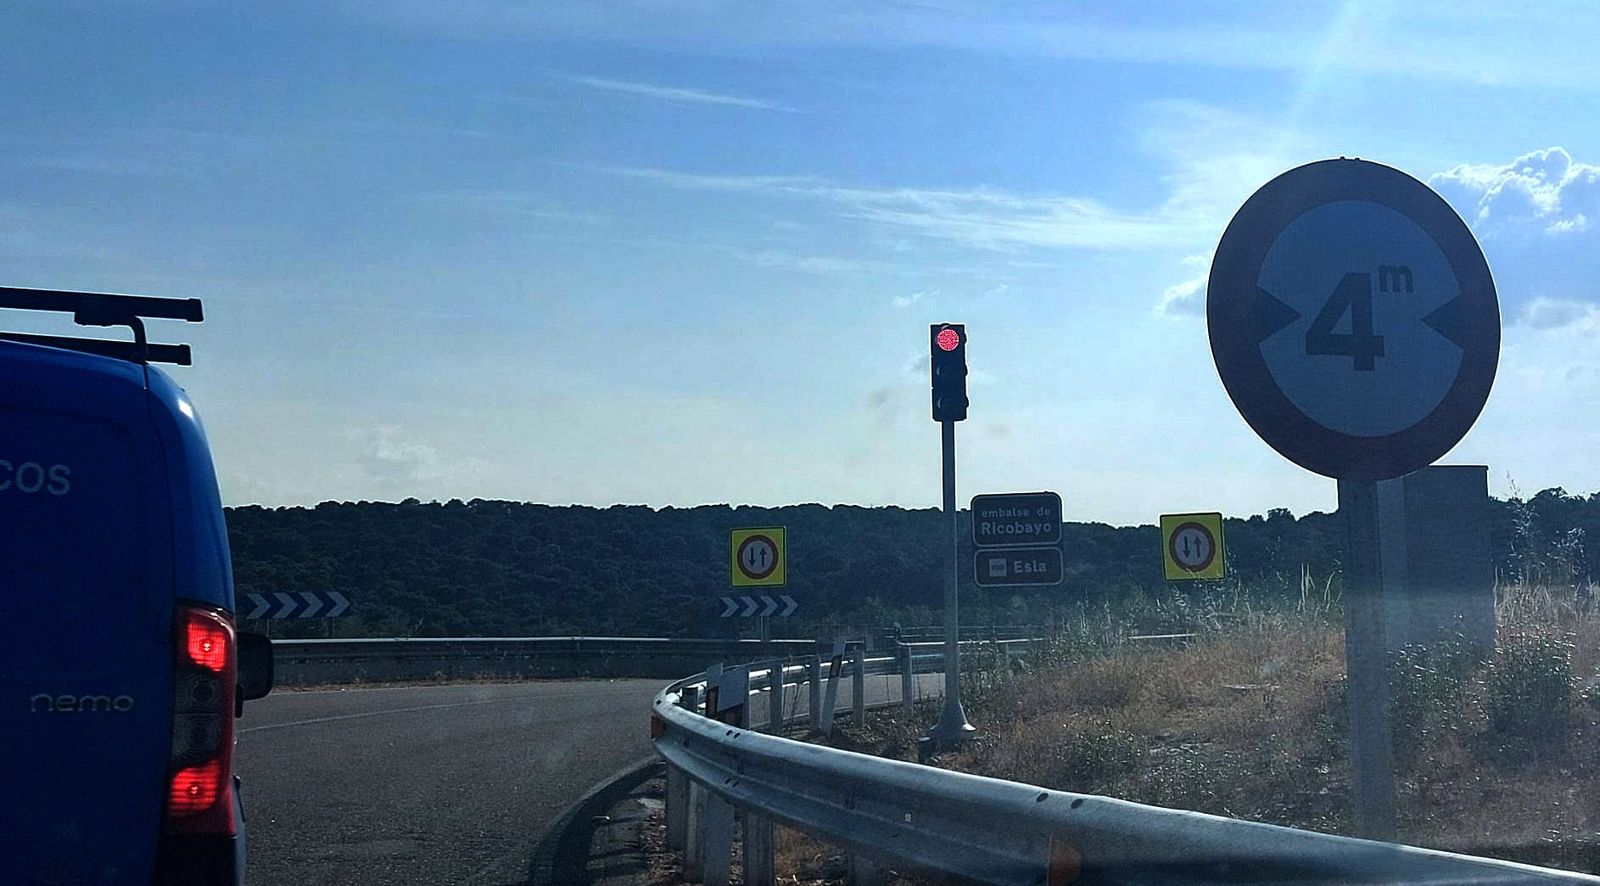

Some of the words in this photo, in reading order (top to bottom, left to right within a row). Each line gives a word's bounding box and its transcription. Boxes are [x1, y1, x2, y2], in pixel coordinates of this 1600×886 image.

[981, 507, 1030, 518] embalse
[1036, 506, 1051, 516] de
[981, 521, 1052, 536] Ricobayo
[1013, 560, 1047, 573] Esla
[30, 693, 134, 712] nemo
